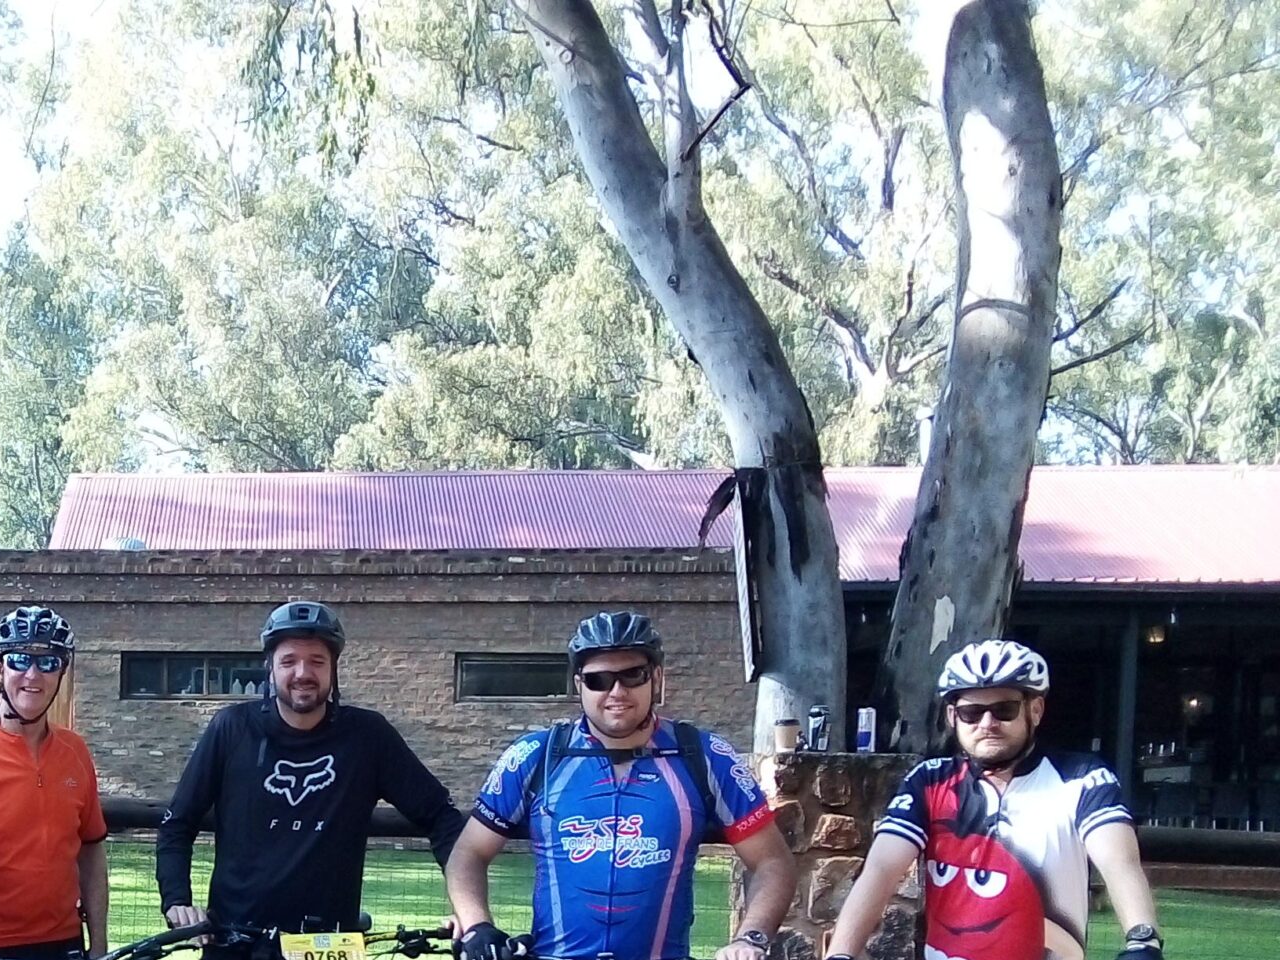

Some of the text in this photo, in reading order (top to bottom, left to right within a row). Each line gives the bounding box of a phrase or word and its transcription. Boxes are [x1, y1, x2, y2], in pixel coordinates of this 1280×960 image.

[270, 819, 324, 831] FOX
[617, 837, 658, 850] FRANS
[629, 849, 671, 867] CYCLES
